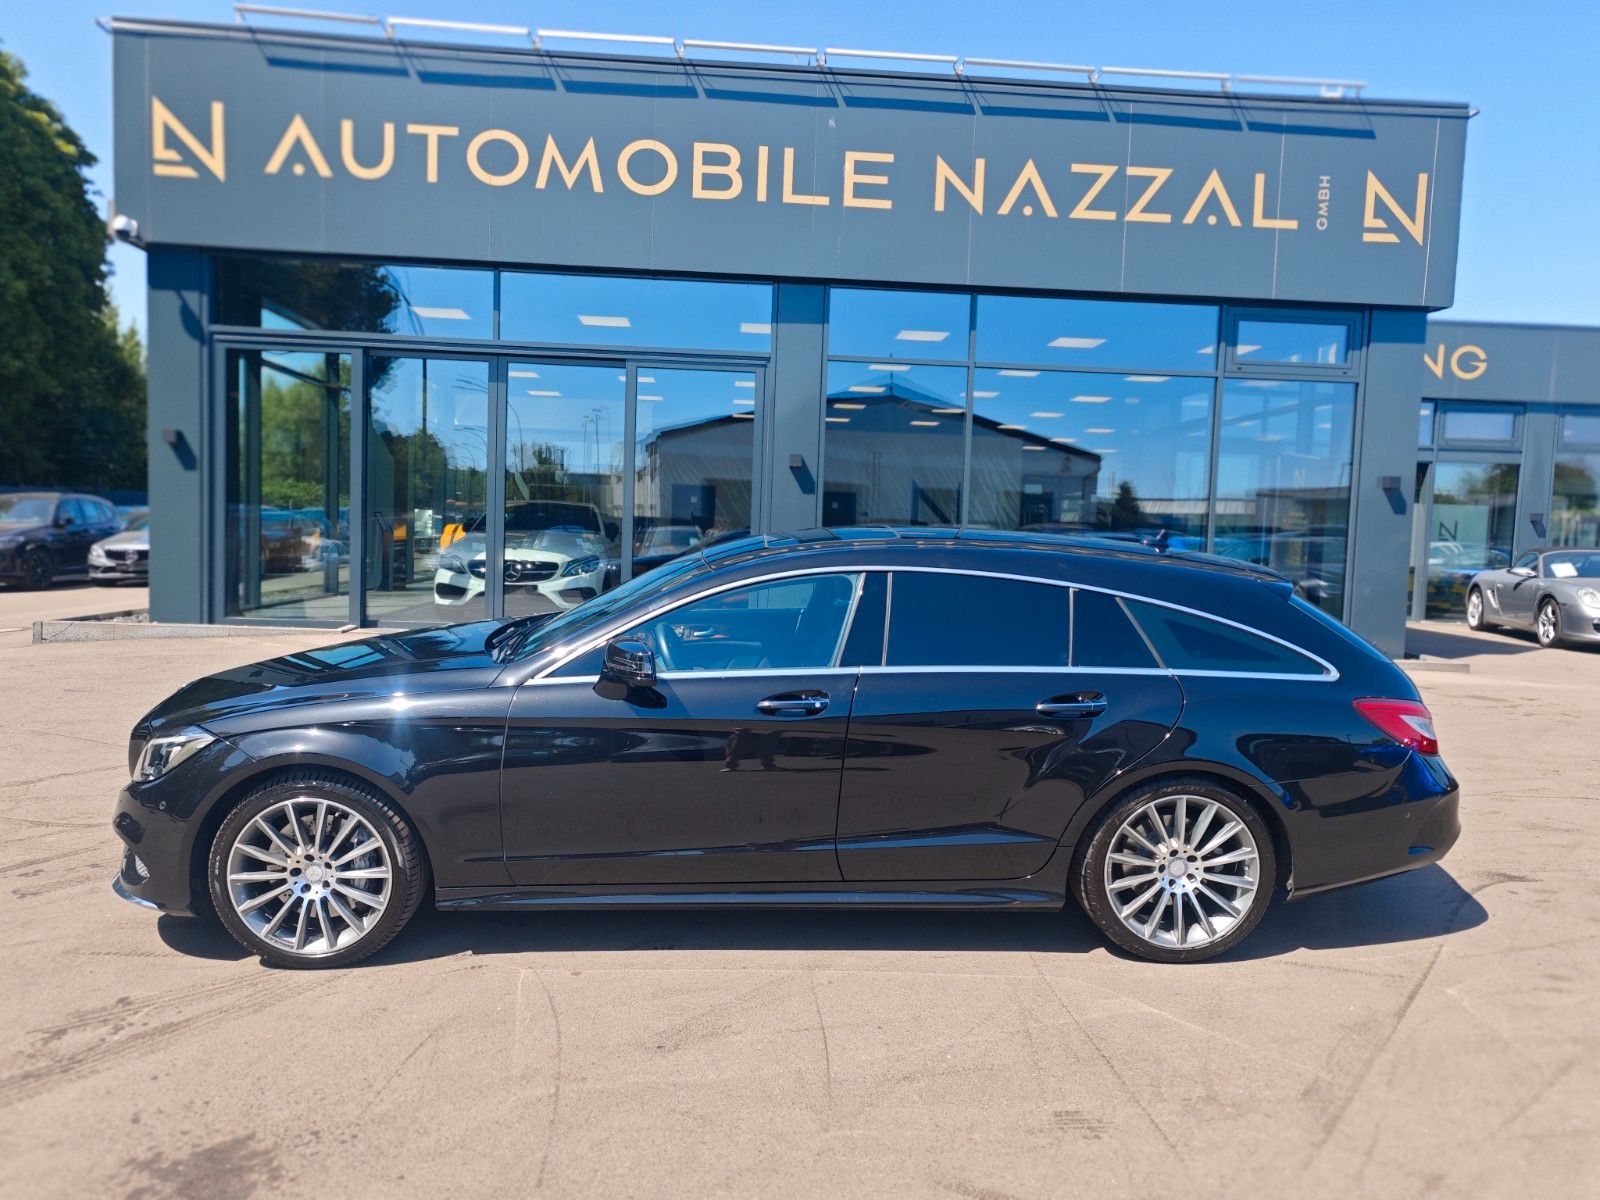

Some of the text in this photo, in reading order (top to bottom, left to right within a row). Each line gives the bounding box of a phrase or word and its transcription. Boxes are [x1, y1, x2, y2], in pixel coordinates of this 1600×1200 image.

[263, 114, 896, 210] AUTOMOBILE
[934, 155, 1300, 231] NAZZAL
[1316, 174, 1332, 231] GMBH
